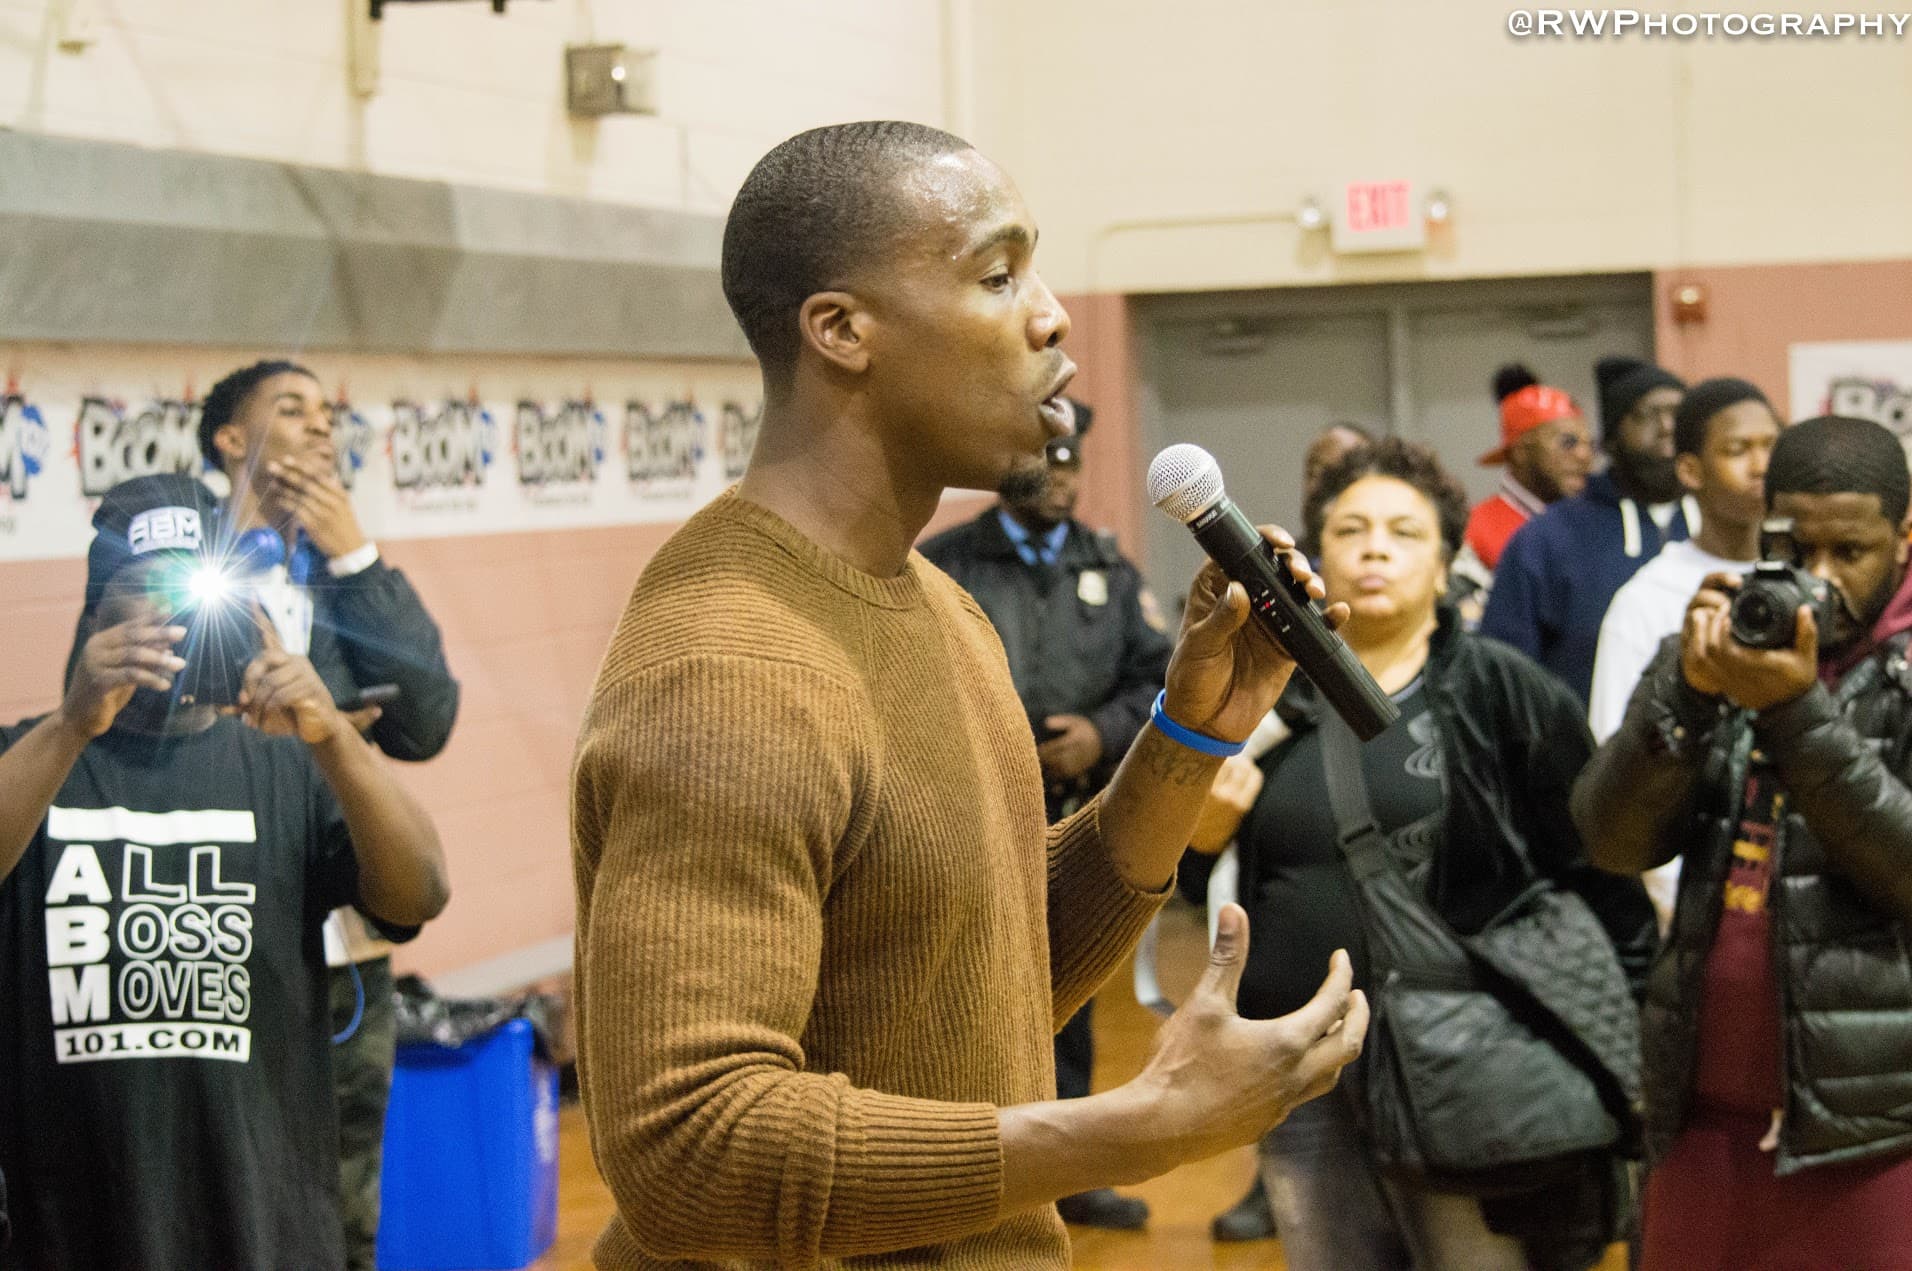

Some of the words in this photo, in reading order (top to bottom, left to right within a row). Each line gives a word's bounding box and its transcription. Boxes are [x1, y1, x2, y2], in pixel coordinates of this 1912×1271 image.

[1346, 181, 1411, 232] EXIT
[128, 506, 202, 555] ABM
[46, 843, 256, 905] ALL
[45, 903, 253, 966] BOSS
[48, 959, 252, 1026] MOVES
[65, 1028, 241, 1057] 101.COM
